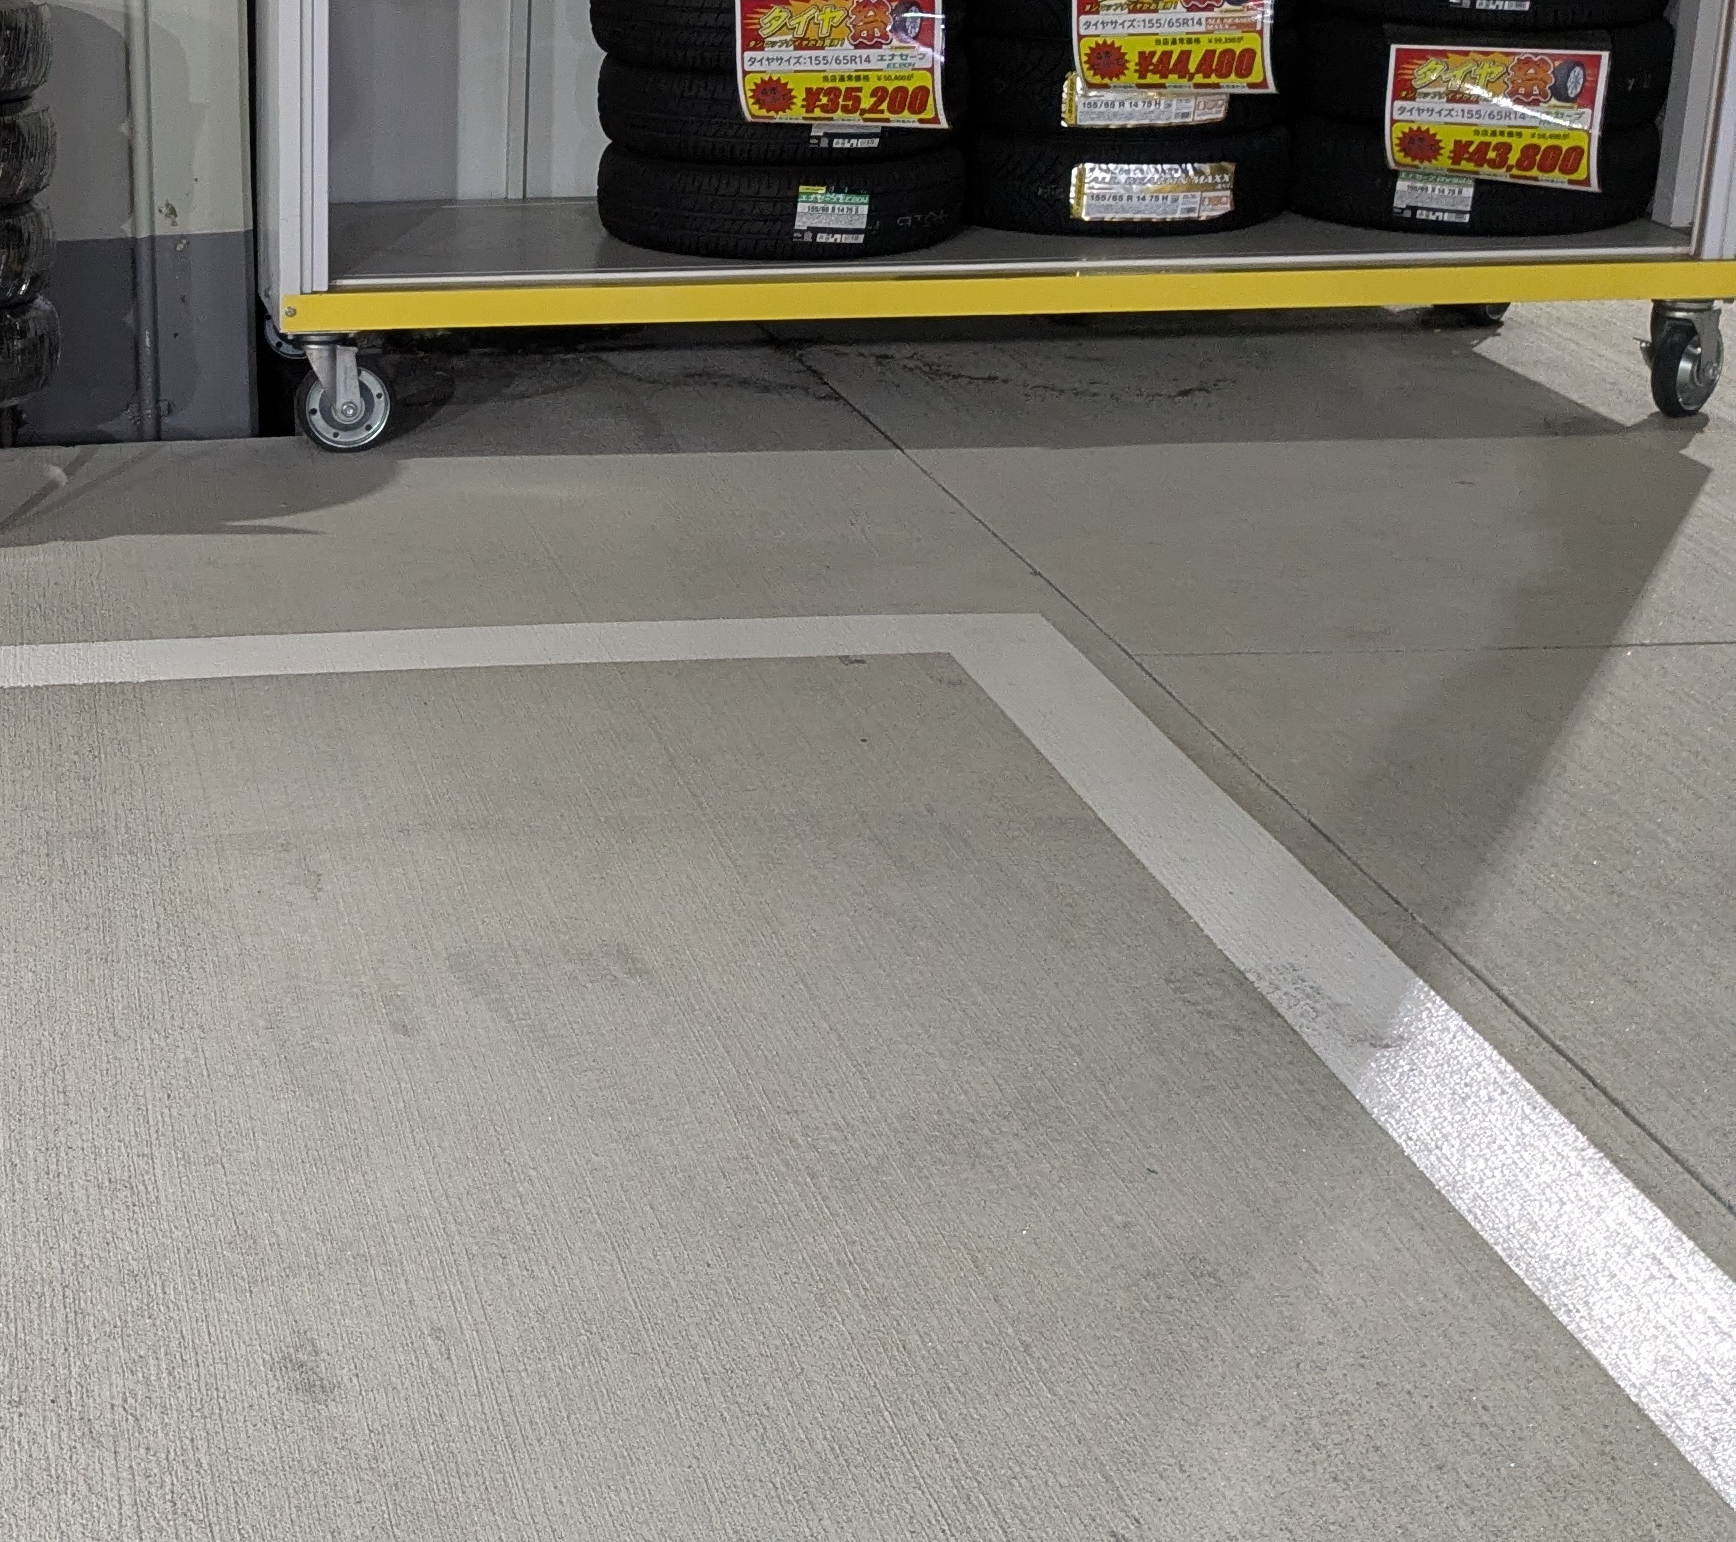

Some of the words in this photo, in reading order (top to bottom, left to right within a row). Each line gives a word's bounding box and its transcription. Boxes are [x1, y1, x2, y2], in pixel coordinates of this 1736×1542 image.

[1134, 47, 1256, 82] ¥44,400
[1412, 53, 1554, 102] タイヤ祭
[801, 85, 930, 116] ¥35,200
[1129, 100, 1138, 109] 14
[1448, 139, 1584, 175] ¥43,800
[1137, 194, 1146, 202] 14
